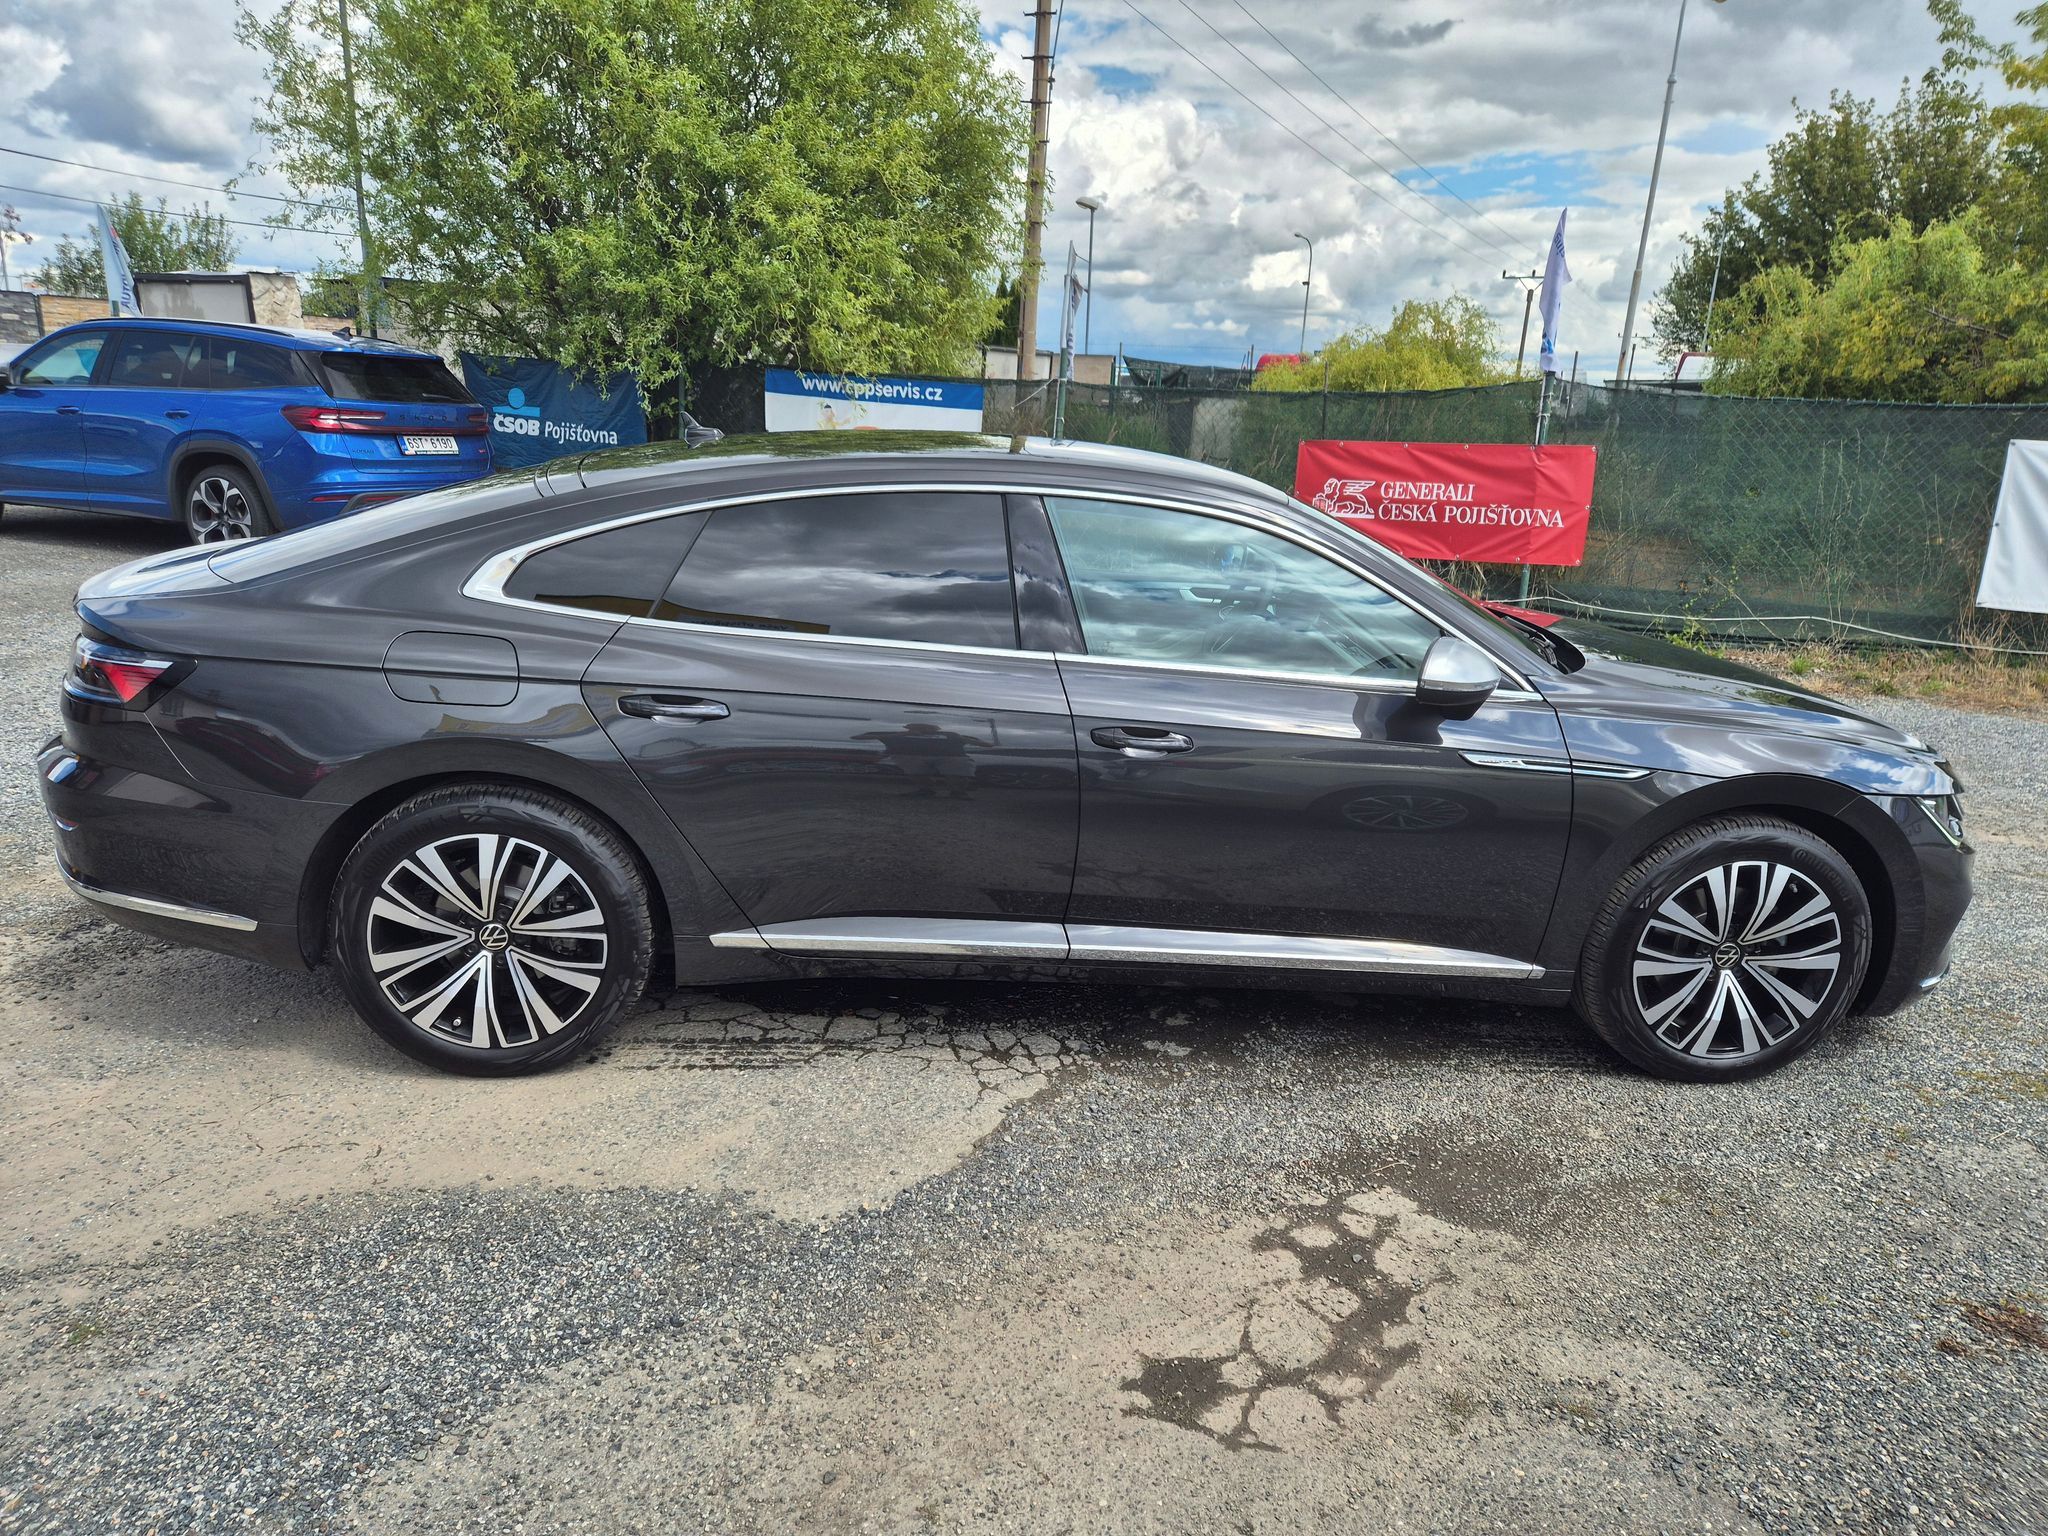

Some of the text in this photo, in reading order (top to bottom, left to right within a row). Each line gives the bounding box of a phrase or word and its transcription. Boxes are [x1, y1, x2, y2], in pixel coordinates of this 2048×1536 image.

[493, 413, 618, 444] ČSOB Pojišťovna
[406, 437, 453, 449] 6ST 6190
[1380, 481, 1475, 501] GENERALI
[1378, 501, 1564, 528] ČESKÁ POJIŠŤOVNA
